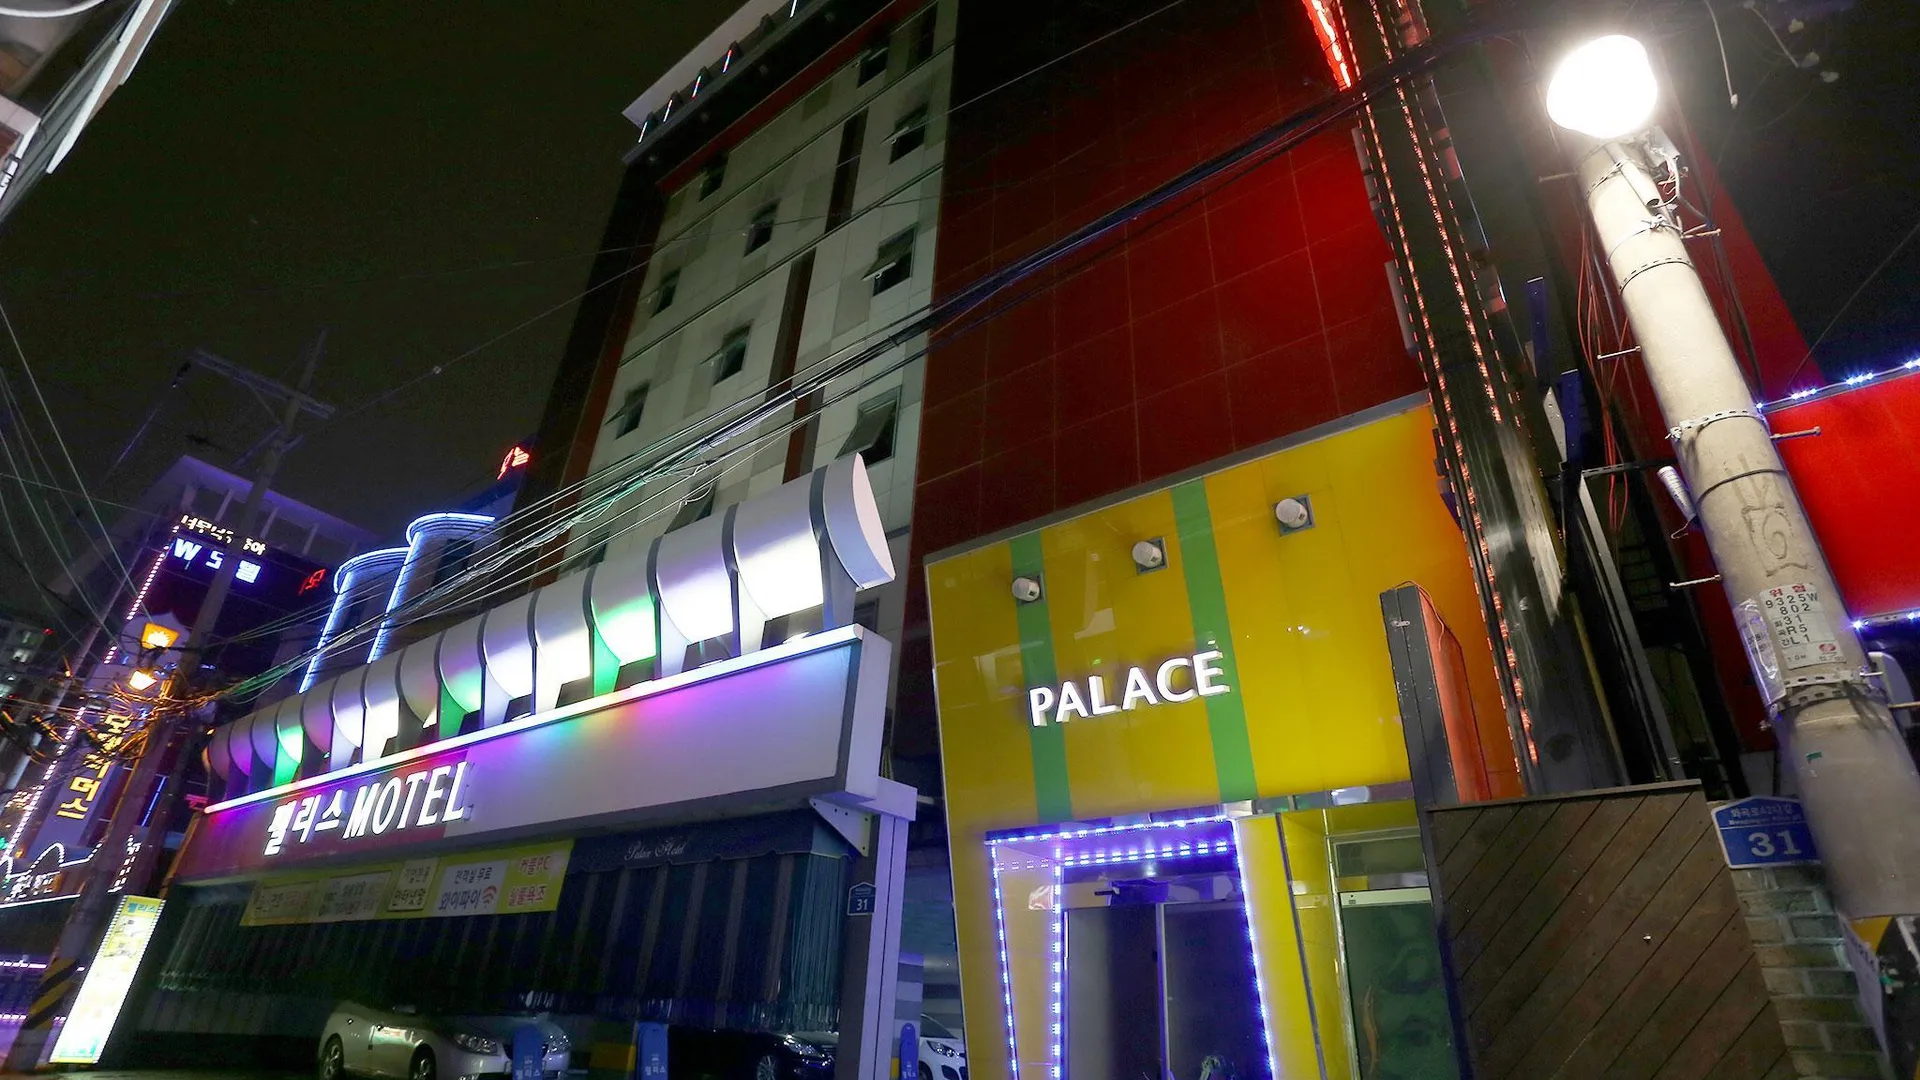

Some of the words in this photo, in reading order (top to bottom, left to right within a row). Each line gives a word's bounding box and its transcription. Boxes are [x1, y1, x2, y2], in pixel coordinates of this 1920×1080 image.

[1765, 592, 1818, 609] 9325W
[1780, 602, 1811, 616] 802
[1783, 614, 1803, 626] 31
[1786, 624, 1808, 636] R5
[1791, 634, 1811, 645] L1
[1028, 650, 1230, 727] PALACE
[264, 789, 342, 856] 팰리스
[342, 761, 468, 840] MOTEL
[1748, 830, 1802, 857] 31
[856, 898, 869, 911] 31
